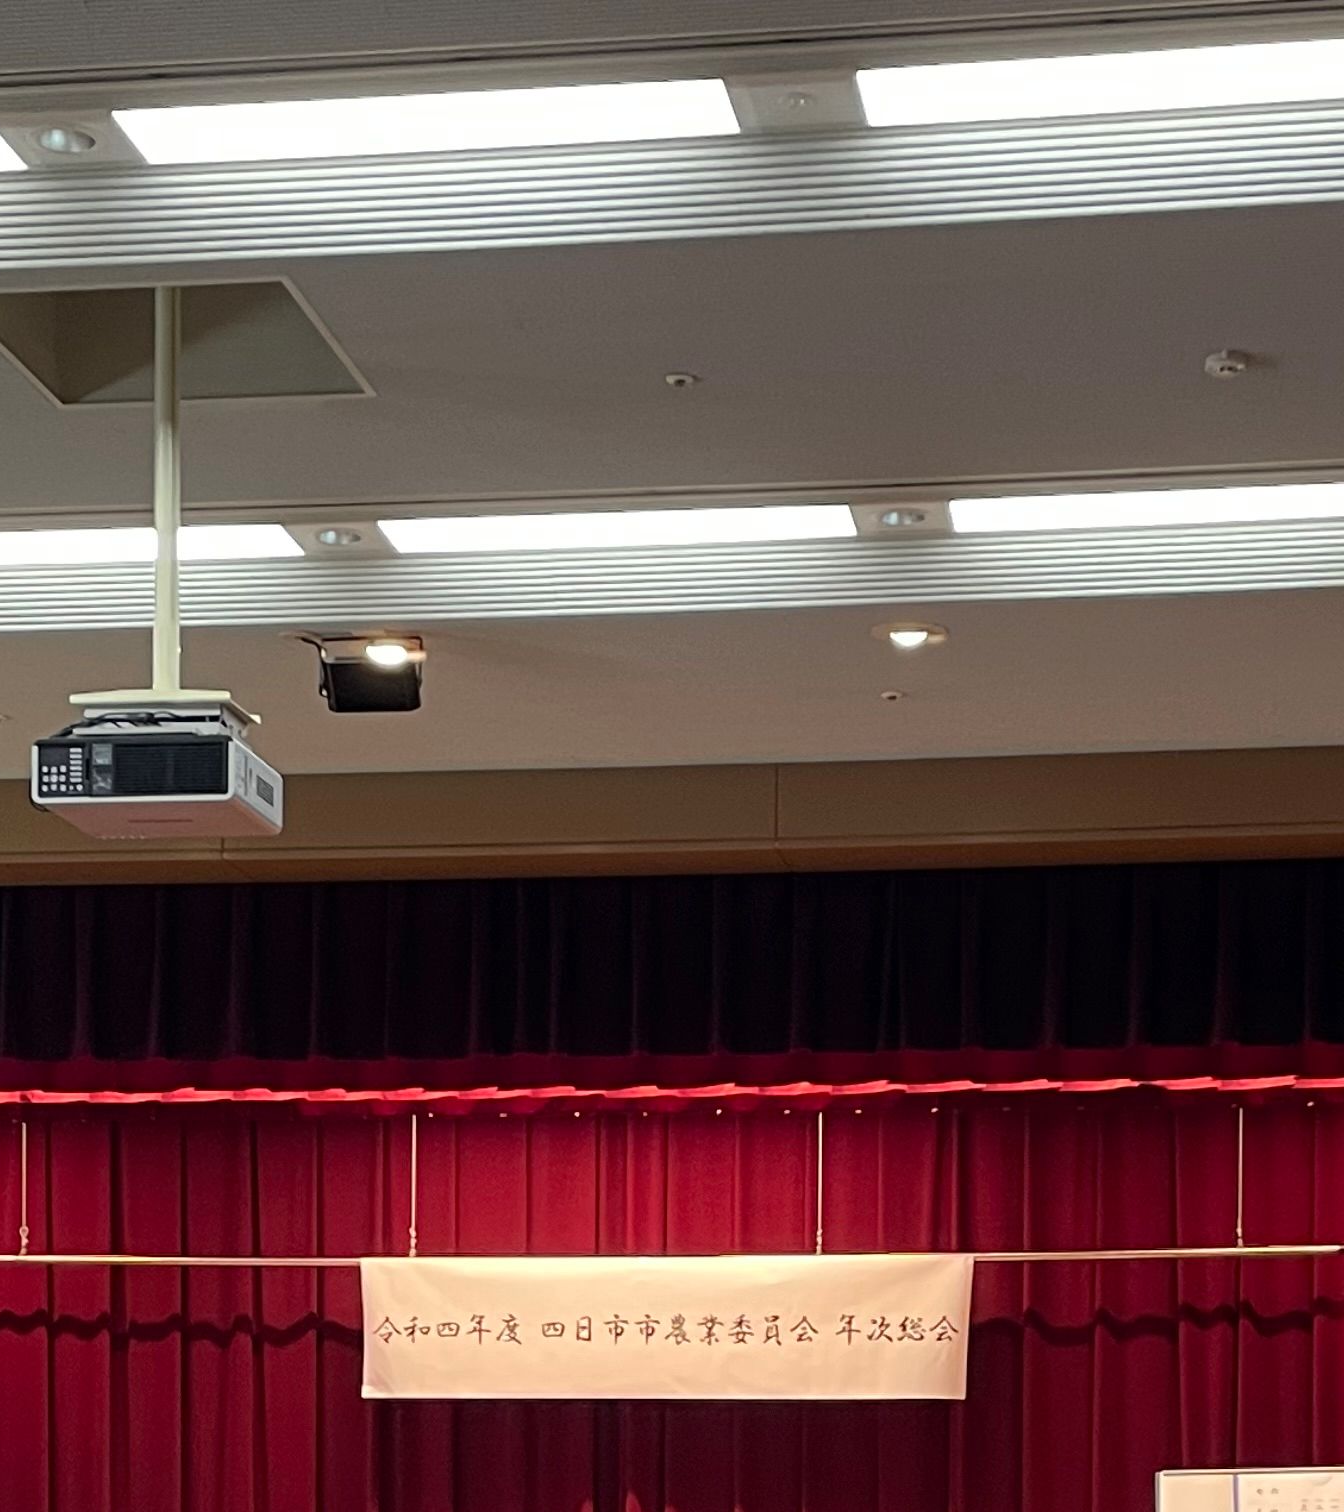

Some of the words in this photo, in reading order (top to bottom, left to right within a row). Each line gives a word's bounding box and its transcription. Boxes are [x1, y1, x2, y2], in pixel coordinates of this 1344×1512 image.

[371, 1312, 524, 1347] 令和四年度
[540, 1312, 820, 1348] 四日市市農業委員会
[834, 1312, 961, 1346] 年次総会
